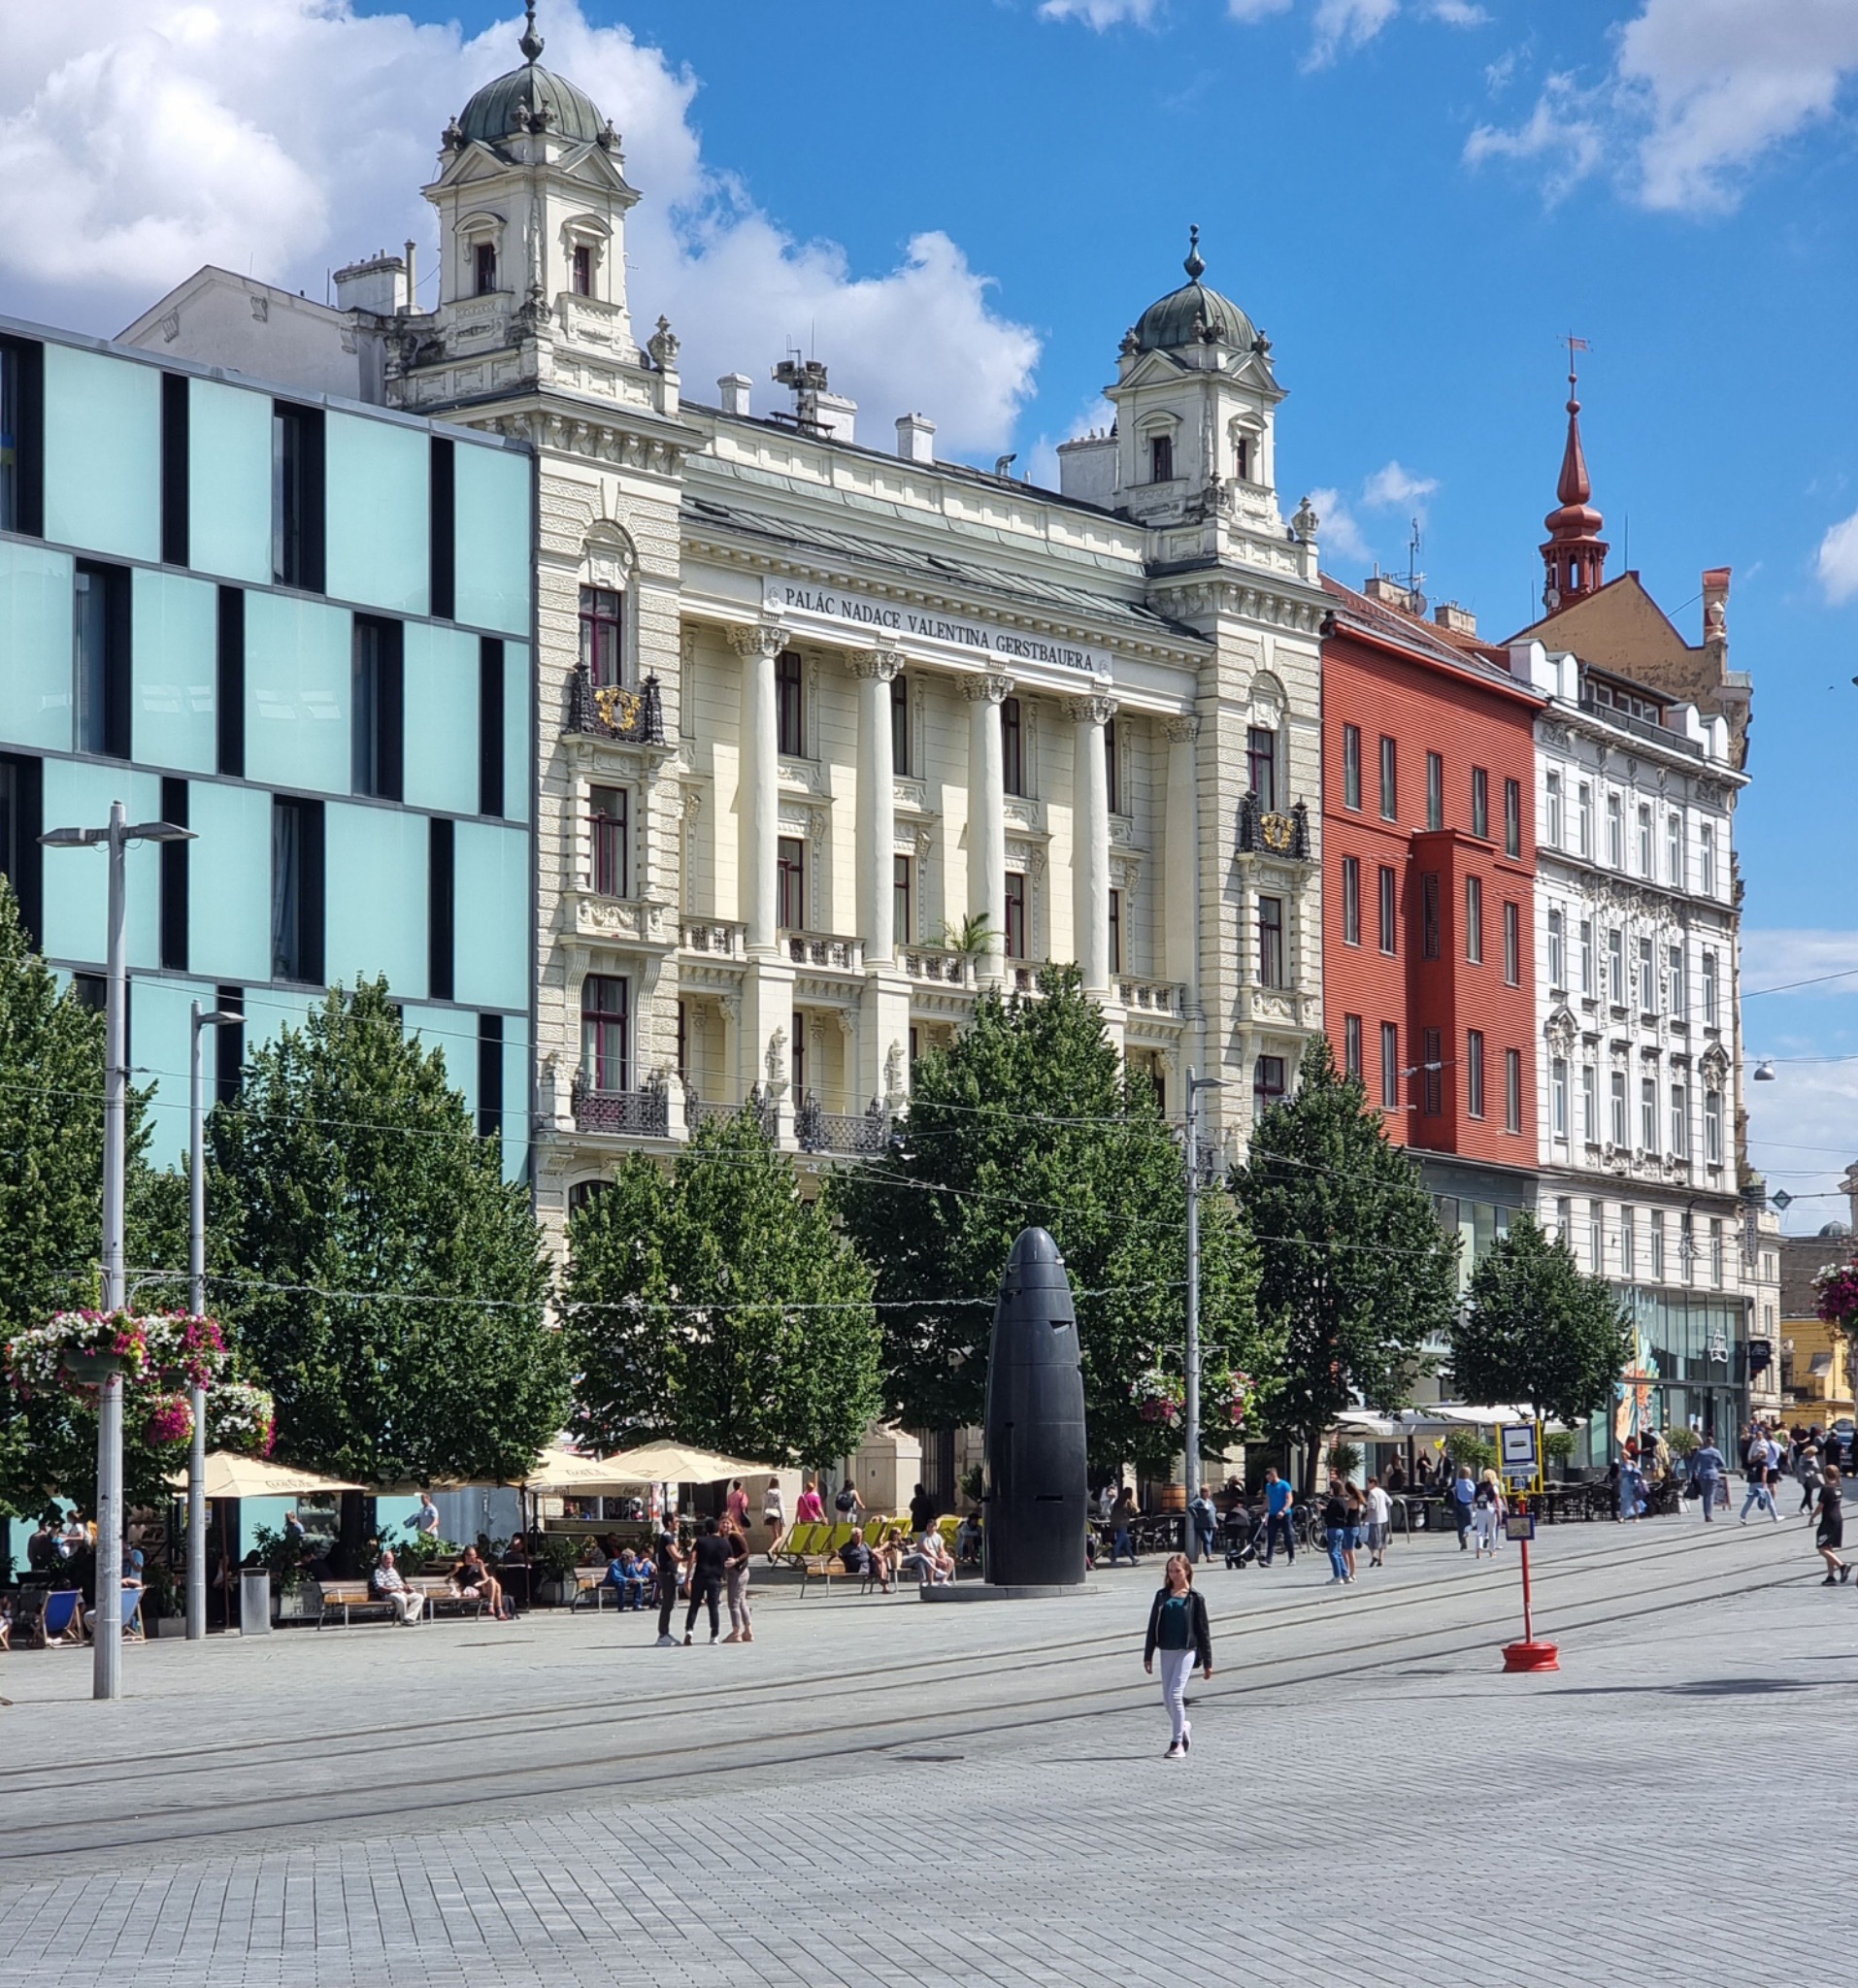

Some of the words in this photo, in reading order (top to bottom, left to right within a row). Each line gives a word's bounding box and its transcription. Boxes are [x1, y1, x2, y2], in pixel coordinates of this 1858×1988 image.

[784, 587, 836, 614] PALÁC
[841, 599, 902, 630] NADACE
[907, 614, 990, 649] VALENTINA
[996, 634, 1094, 672] GERSTBAUERA
